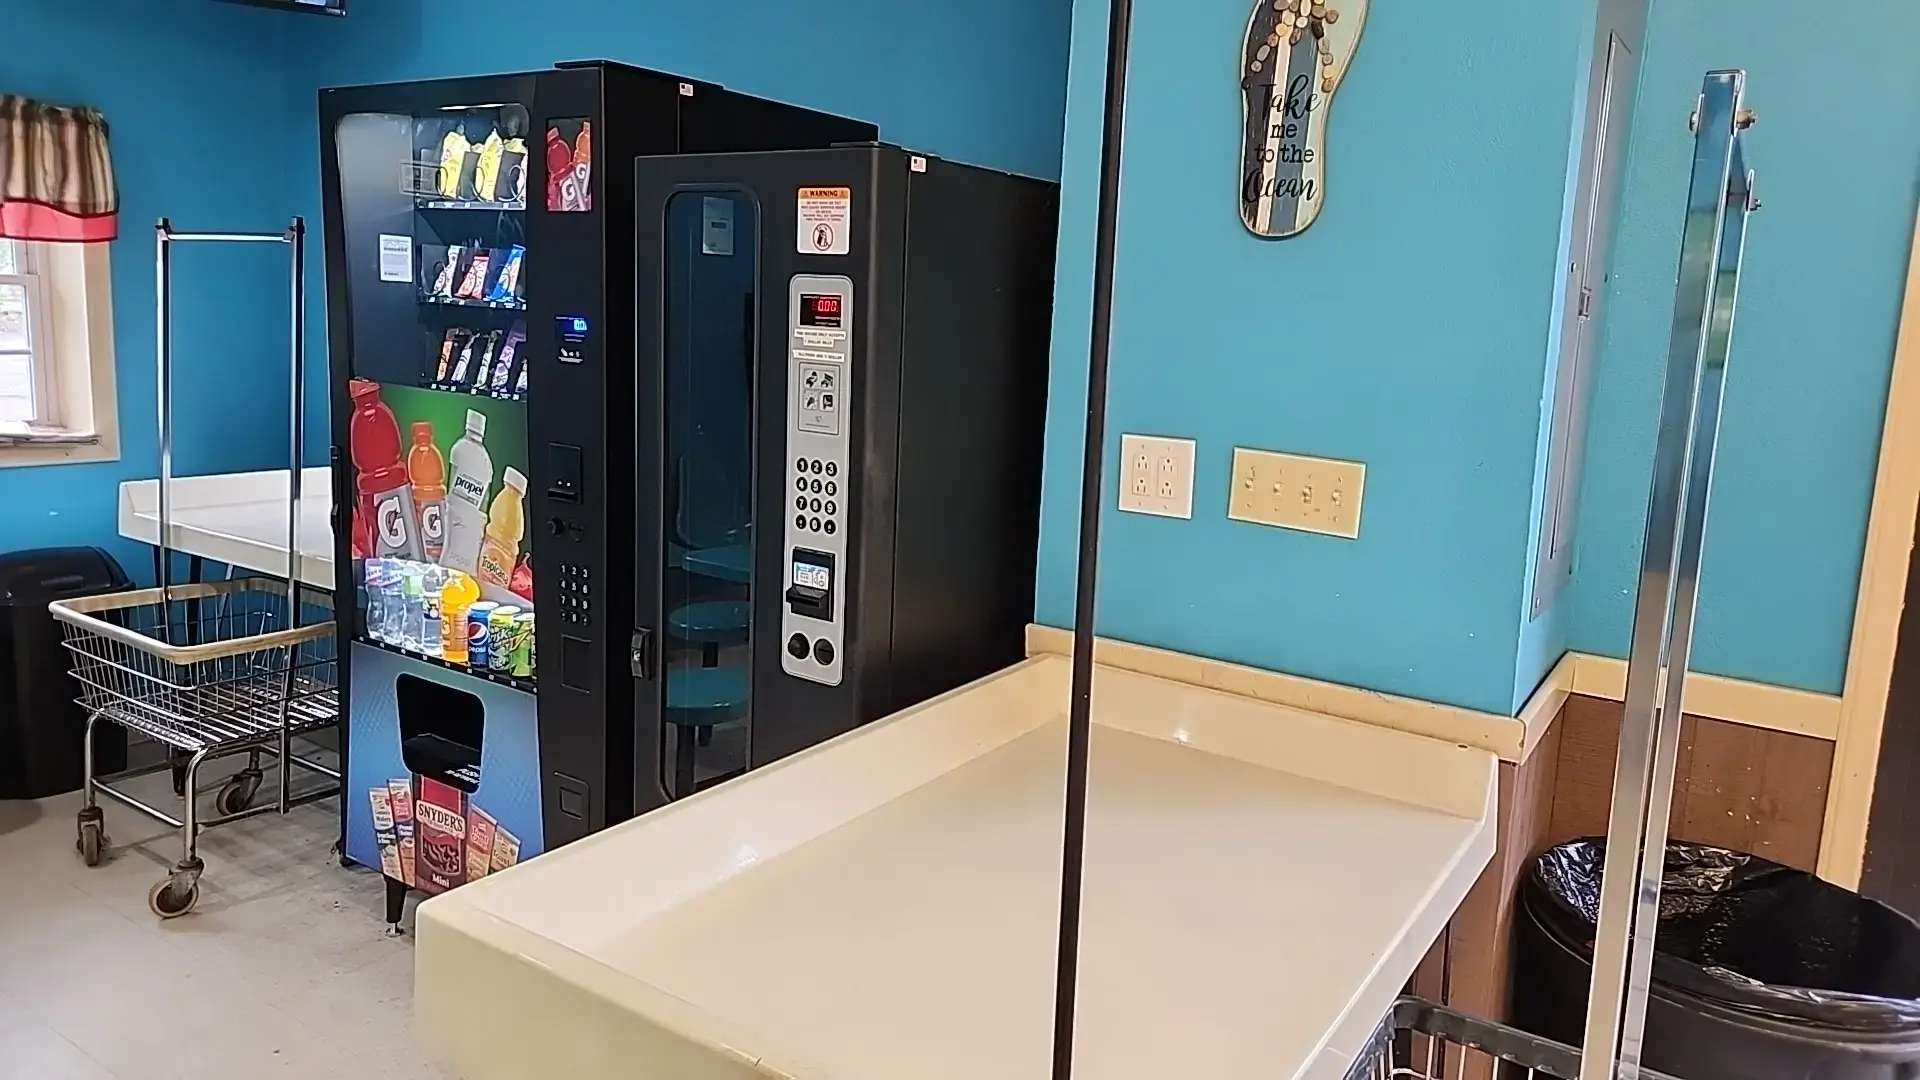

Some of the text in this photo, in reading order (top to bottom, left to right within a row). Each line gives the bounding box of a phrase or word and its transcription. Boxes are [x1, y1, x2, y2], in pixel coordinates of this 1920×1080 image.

[1243, 74, 1321, 120] Take
[1270, 123, 1298, 138] me
[1255, 144, 1314, 163] to the
[576, 163, 586, 180] G
[561, 177, 576, 201] G
[1244, 168, 1318, 204] Ocean
[800, 460, 834, 474] 1 2 3
[454, 476, 484, 496] propel
[798, 480, 834, 494] 4 5 6
[799, 499, 833, 513] 7 8 9
[378, 496, 406, 548] G
[423, 505, 442, 538] G
[812, 520, 818, 530] 0
[482, 556, 508, 585] Tropicana
[561, 565, 588, 578] 1 2 3
[561, 580, 588, 593] 4 5 6
[561, 596, 565, 604] 7
[418, 804, 463, 832] SNYDER'S
[432, 873, 450, 888] Mini
